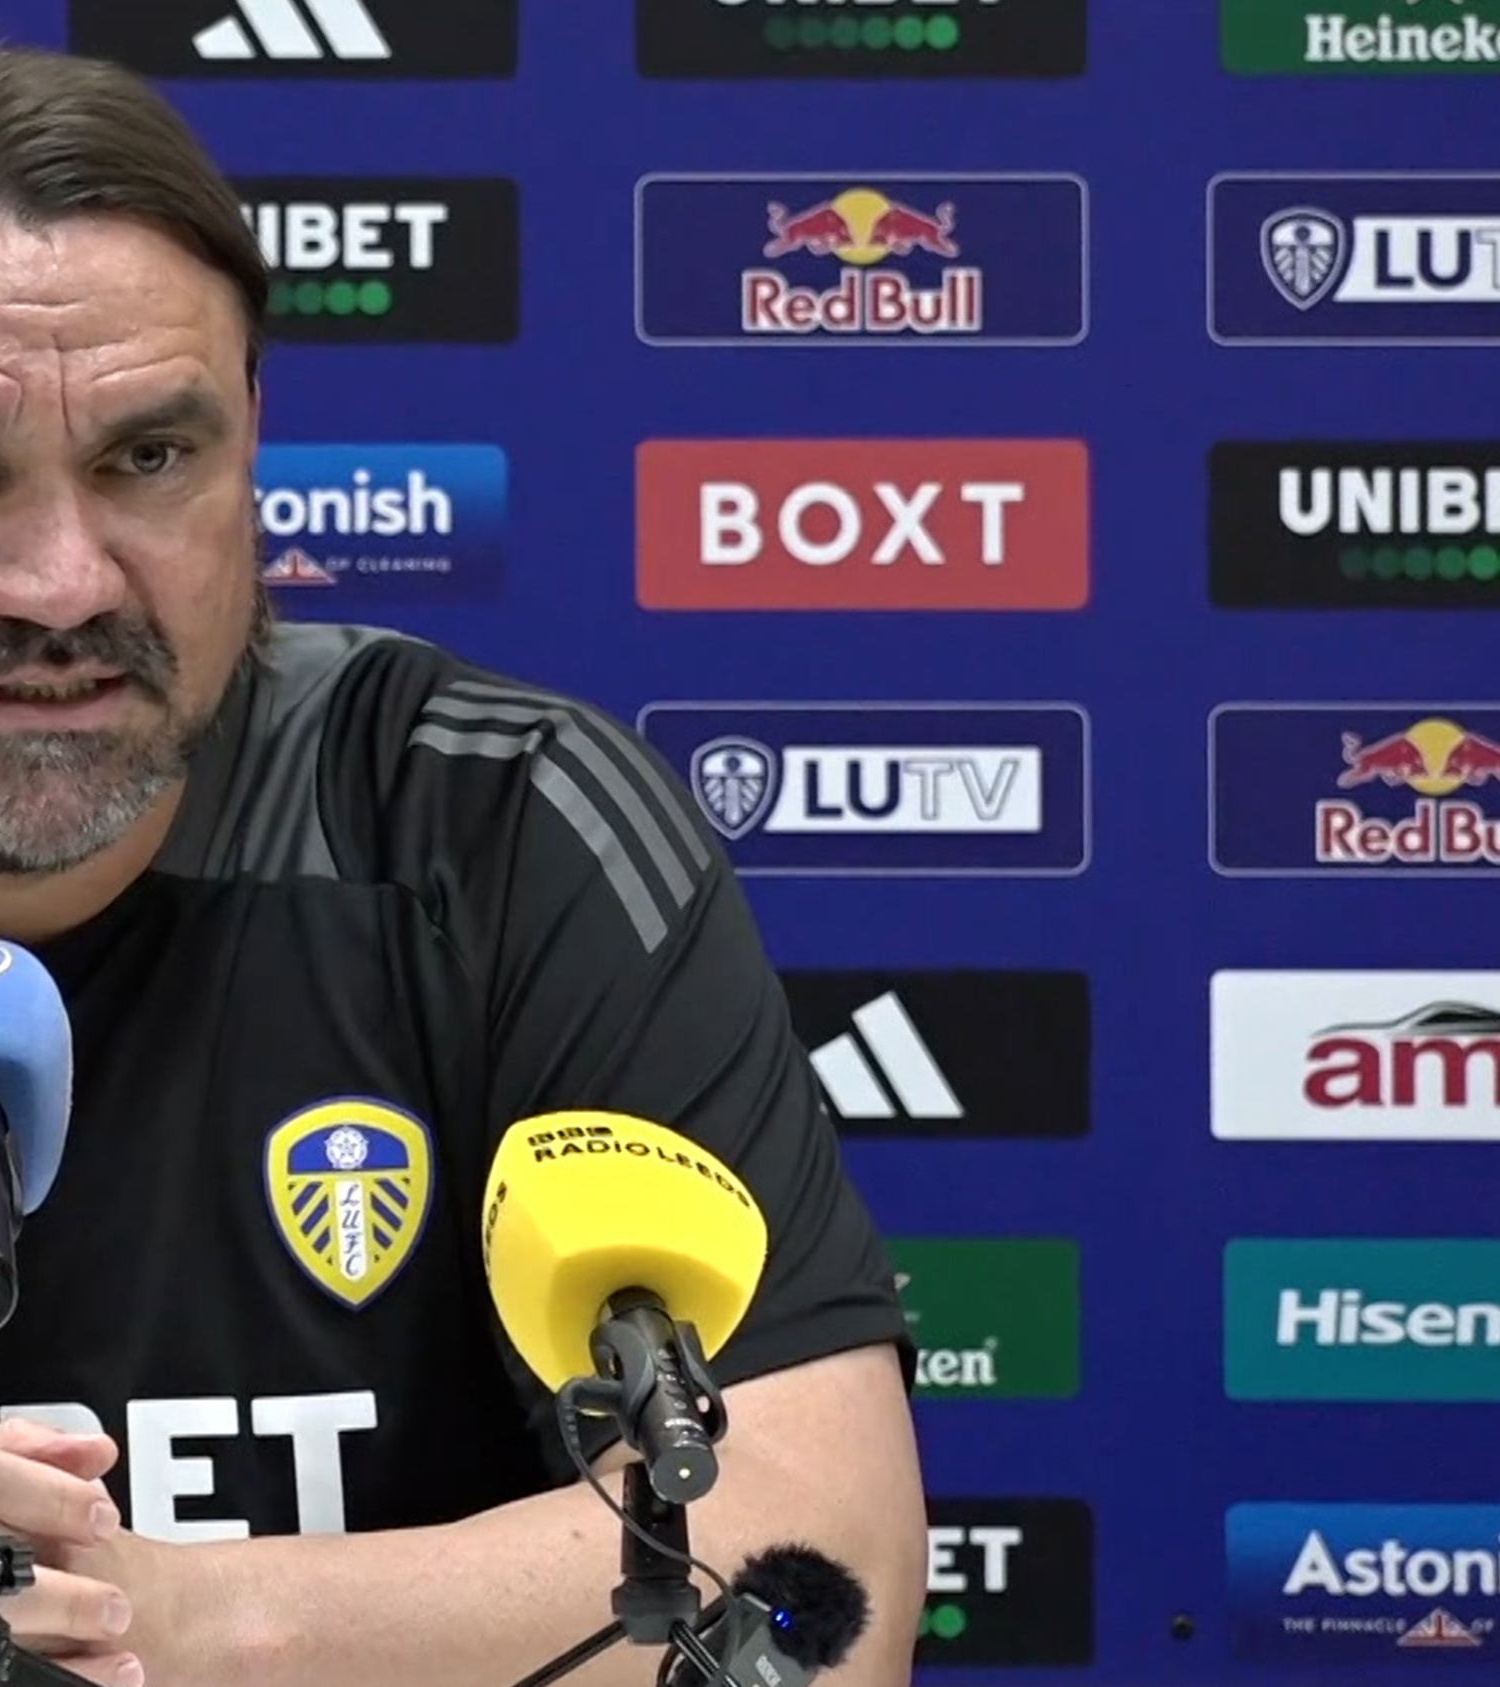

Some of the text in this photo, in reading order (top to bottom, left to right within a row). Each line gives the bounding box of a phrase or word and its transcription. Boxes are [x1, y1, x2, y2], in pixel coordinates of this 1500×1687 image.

[1304, 13, 1500, 62] Heinek
[241, 203, 448, 271] IBET
[742, 267, 982, 332] Red Bull
[255, 468, 452, 537] onish
[699, 482, 1026, 566] BOXT
[803, 758, 1020, 822] LUTV
[1315, 798, 1437, 863] Red
[1281, 1529, 1500, 1597] Aston
[1282, 1616, 1316, 1633] THE
